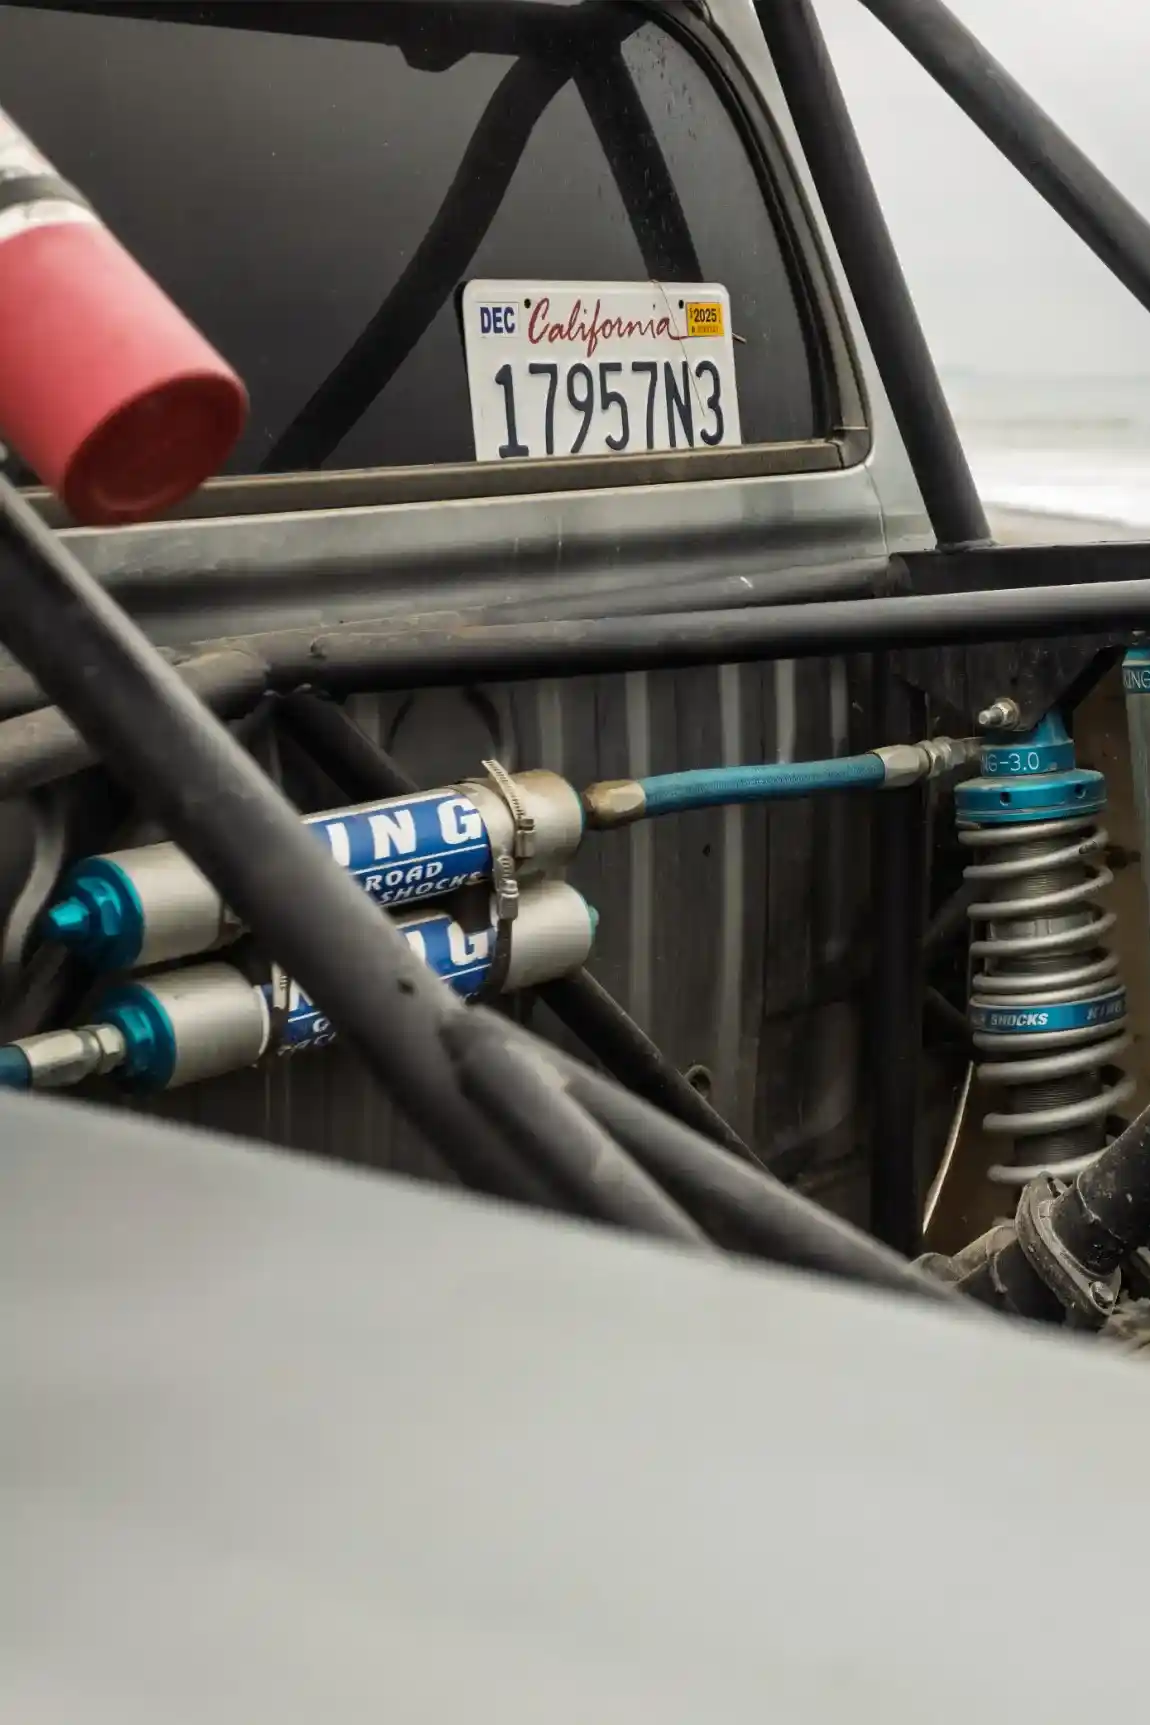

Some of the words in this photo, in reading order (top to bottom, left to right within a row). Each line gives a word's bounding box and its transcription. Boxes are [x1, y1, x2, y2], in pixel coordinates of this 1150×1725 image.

[479, 306, 516, 334] DEC
[527, 297, 690, 357] California
[694, 308, 718, 323] 2025
[494, 359, 725, 459] 17957N3
[990, 1011, 1050, 1028] SHOCKS
